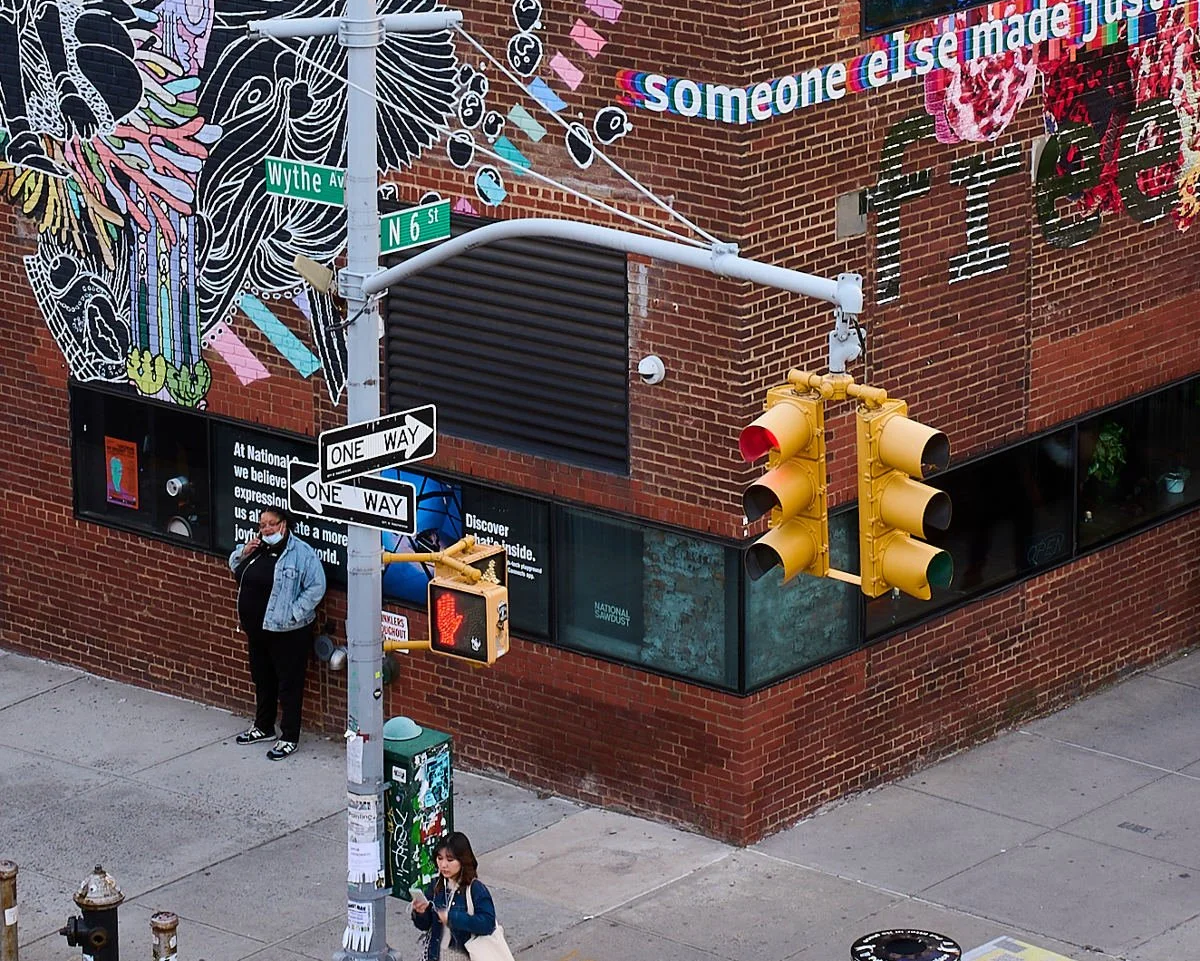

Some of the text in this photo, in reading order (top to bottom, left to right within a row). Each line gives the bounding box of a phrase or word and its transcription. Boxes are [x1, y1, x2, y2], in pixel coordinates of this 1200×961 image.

[642, 61, 847, 125] someone
[867, 30, 959, 87] else
[267, 161, 322, 194] Wythe
[389, 207, 439, 247] N 6 St
[233, 441, 290, 469] At National
[331, 425, 420, 465] ONE WAY
[233, 465, 287, 490] we believe
[234, 486, 288, 510] expression
[306, 480, 403, 516] ONE WAY
[234, 506, 247, 520] us
[465, 512, 510, 538] Discover
[312, 527, 320, 539] a
[322, 528, 348, 547] more
[315, 544, 341, 566] orld.
[594, 600, 630, 618] NATIONAL
[594, 609, 631, 627] SAWDUST
